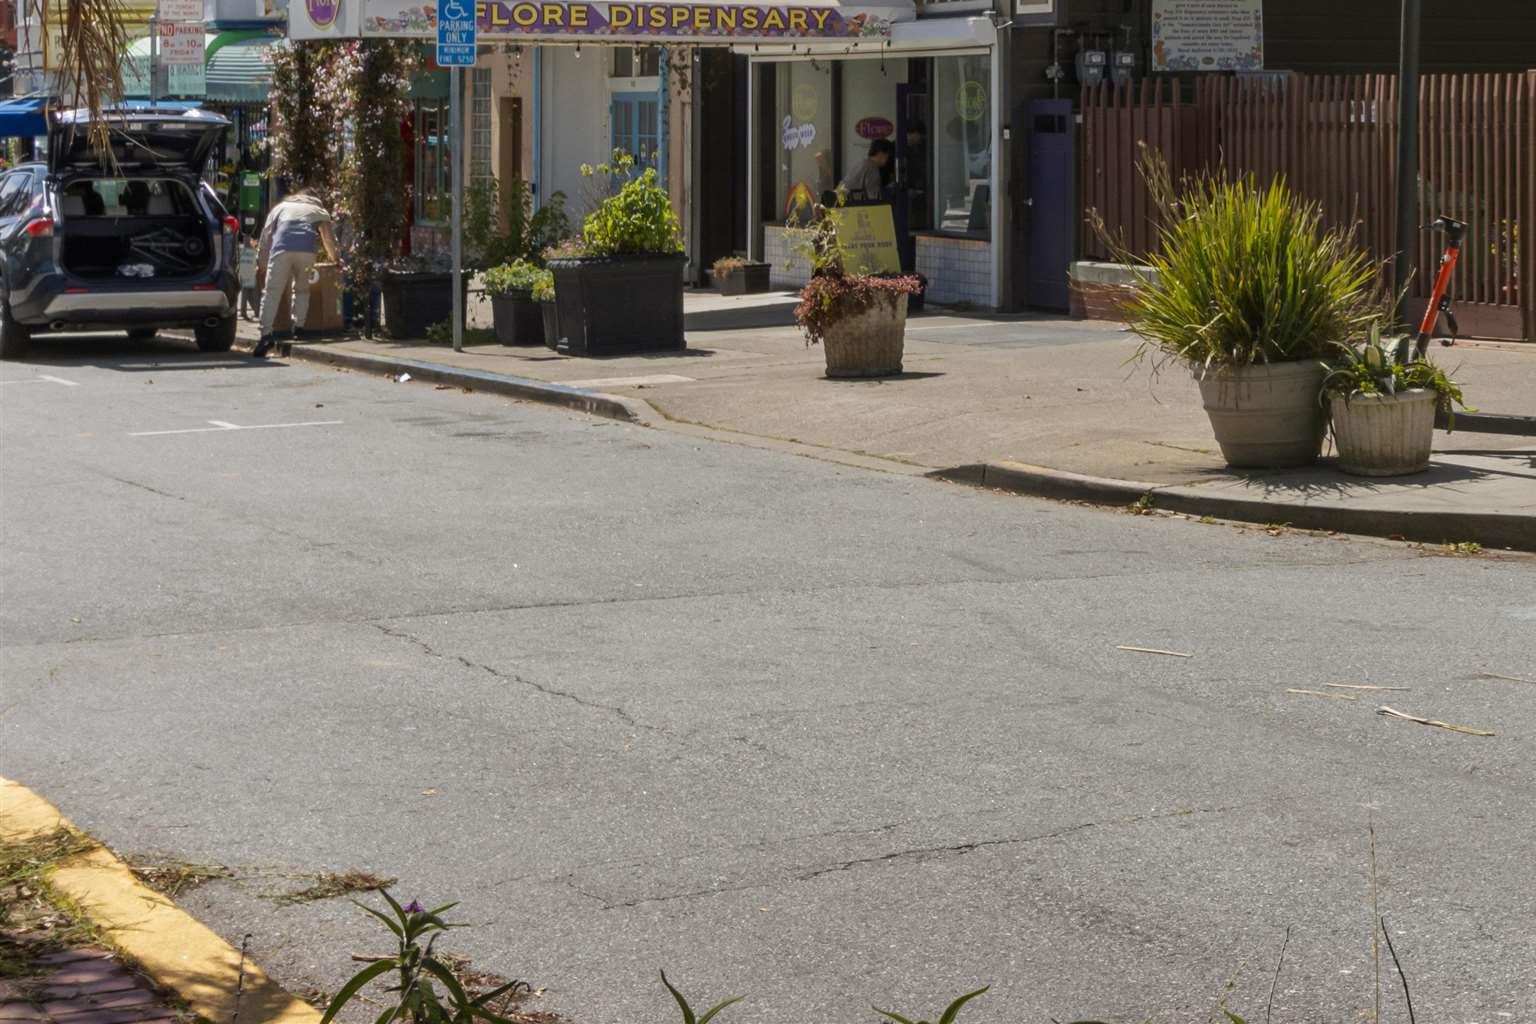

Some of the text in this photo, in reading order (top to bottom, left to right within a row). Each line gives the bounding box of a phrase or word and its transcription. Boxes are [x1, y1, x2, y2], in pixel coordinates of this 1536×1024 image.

[609, 5, 832, 29] DISPENSARY
[161, 23, 173, 35] NO
[439, 19, 473, 30] PARKING
[446, 32, 467, 43] ONLY
